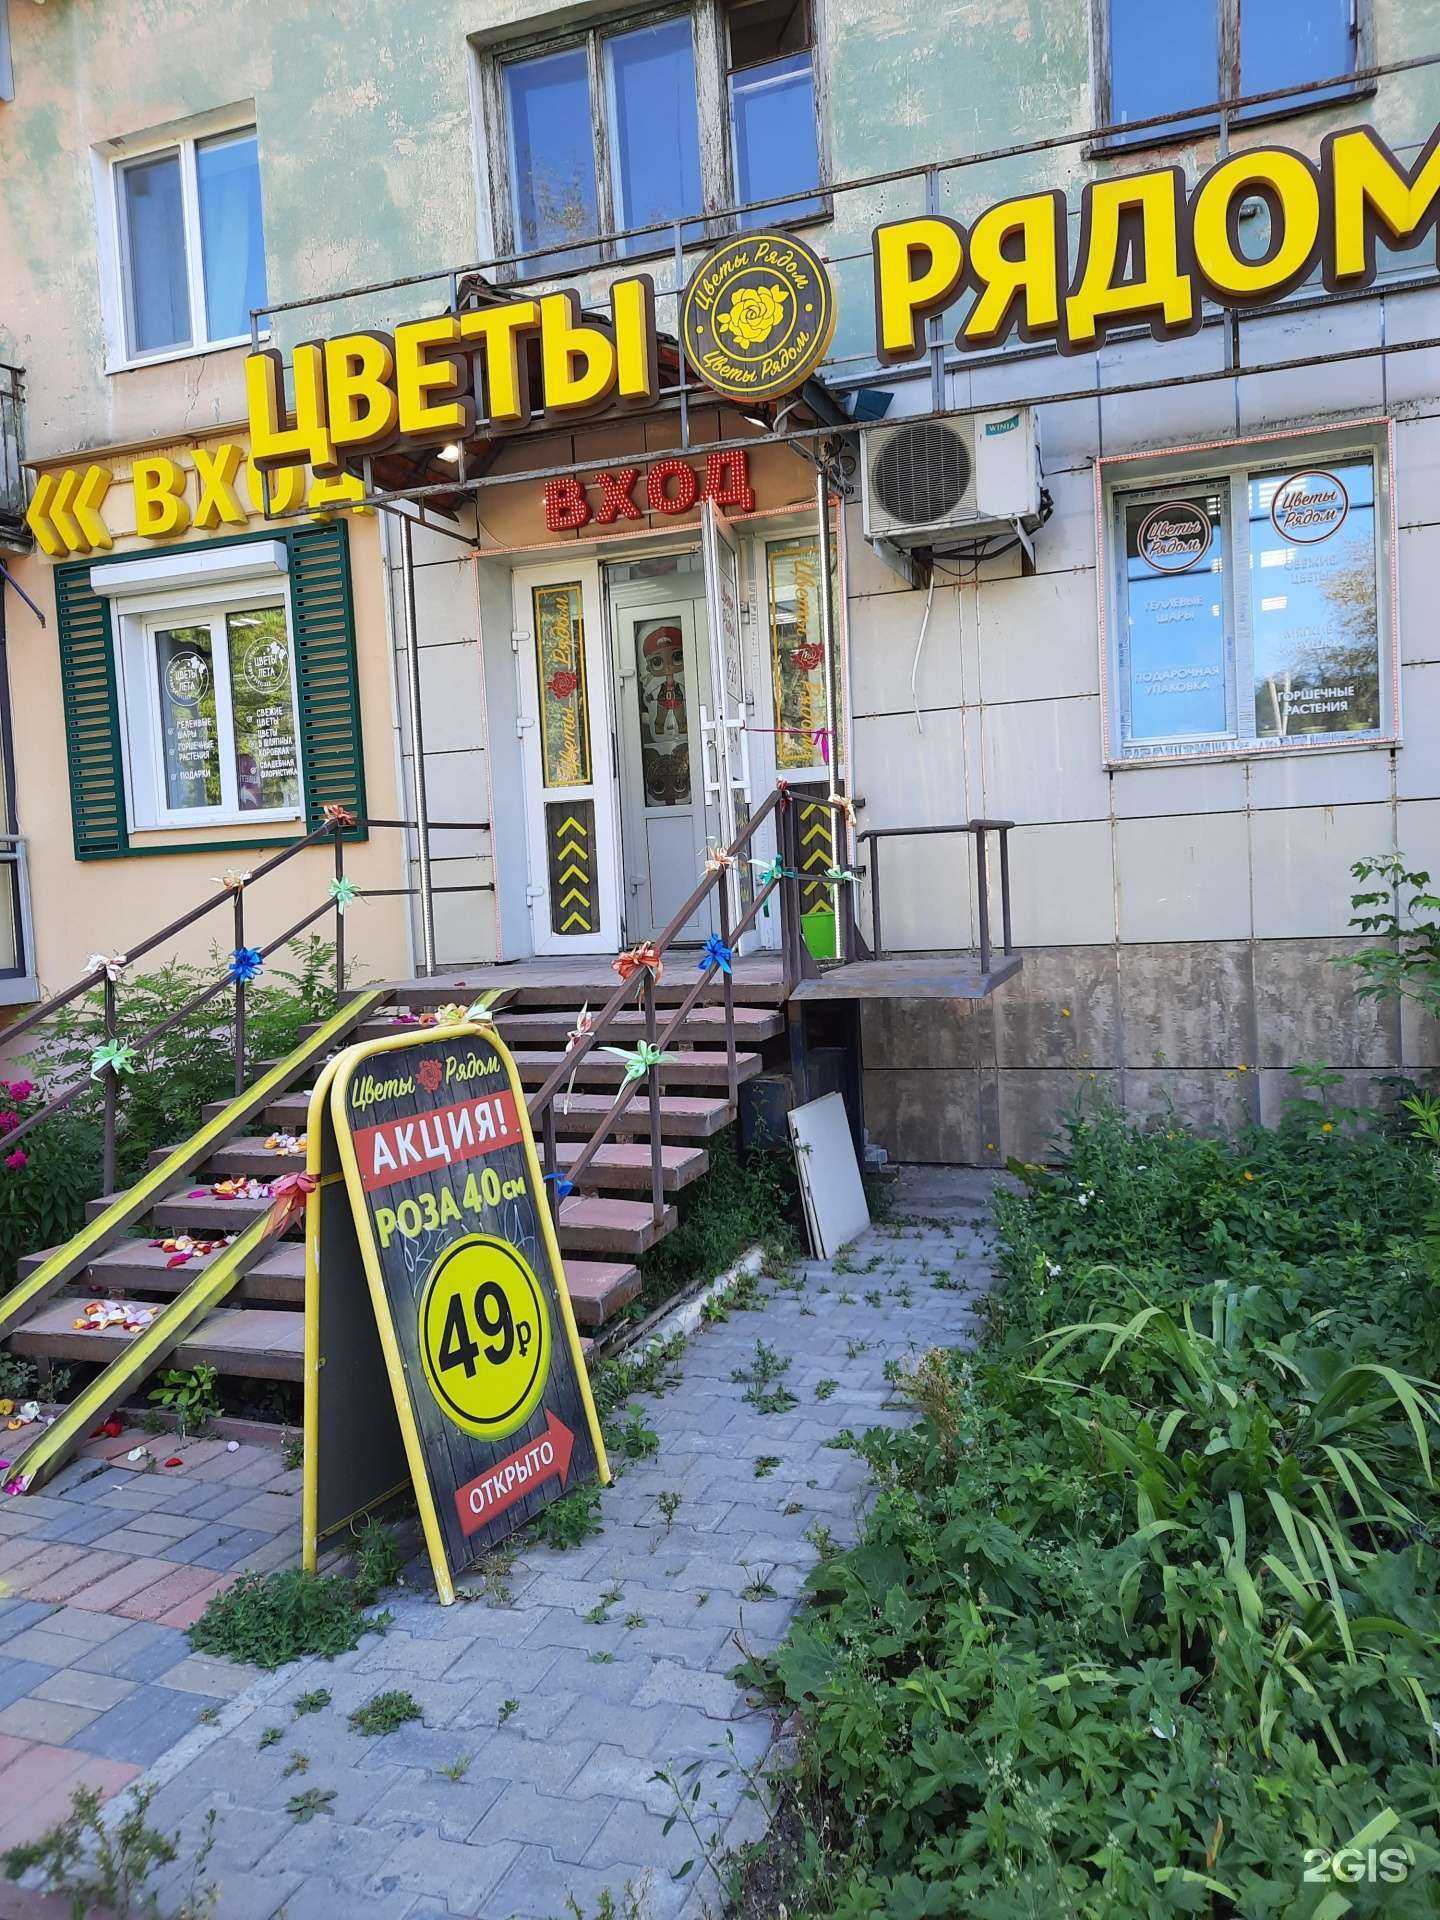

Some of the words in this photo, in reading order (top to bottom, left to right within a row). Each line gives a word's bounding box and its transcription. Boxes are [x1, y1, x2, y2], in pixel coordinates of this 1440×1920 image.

[694, 252, 749, 311] Цветы
[754, 242, 810, 290] Рядом
[246, 279, 652, 471] ЦВЕТЫ
[877, 130, 1440, 353] РЯДОМ
[702, 350, 758, 383] Цветы
[761, 331, 810, 380] Рядом
[989, 422, 1016, 432] WINIA
[544, 449, 756, 531] ВХОД
[1282, 489, 1337, 511] Цветы
[1284, 509, 1337, 528] Рядом
[1147, 521, 1201, 540] Цветы
[1150, 537, 1201, 558] Рядом
[254, 654, 277, 666] ЦВЕТЫ
[1135, 666, 1219, 683] ПОДАРОЧНАЯ
[1145, 681, 1210, 696] УПАКОВКА
[1278, 686, 1354, 702] ГОРШЕЧНЫЕ
[256, 706, 284, 718] СВЕЖИЕ
[1285, 701, 1348, 715] РАСТЕНИЯ
[256, 717, 279, 728] ЦВЕТЫ
[257, 729, 279, 739] ЦВЕТЫ
[180, 770, 211, 781] ПОДАРКИ
[352, 1075, 415, 1112] Цветы
[445, 1052, 501, 1085] Рядом
[373, 1098, 508, 1175] АКЦИЯ!
[375, 1187, 463, 1249] РОЗА
[469, 1441, 554, 1514] ОТКРЫТО
